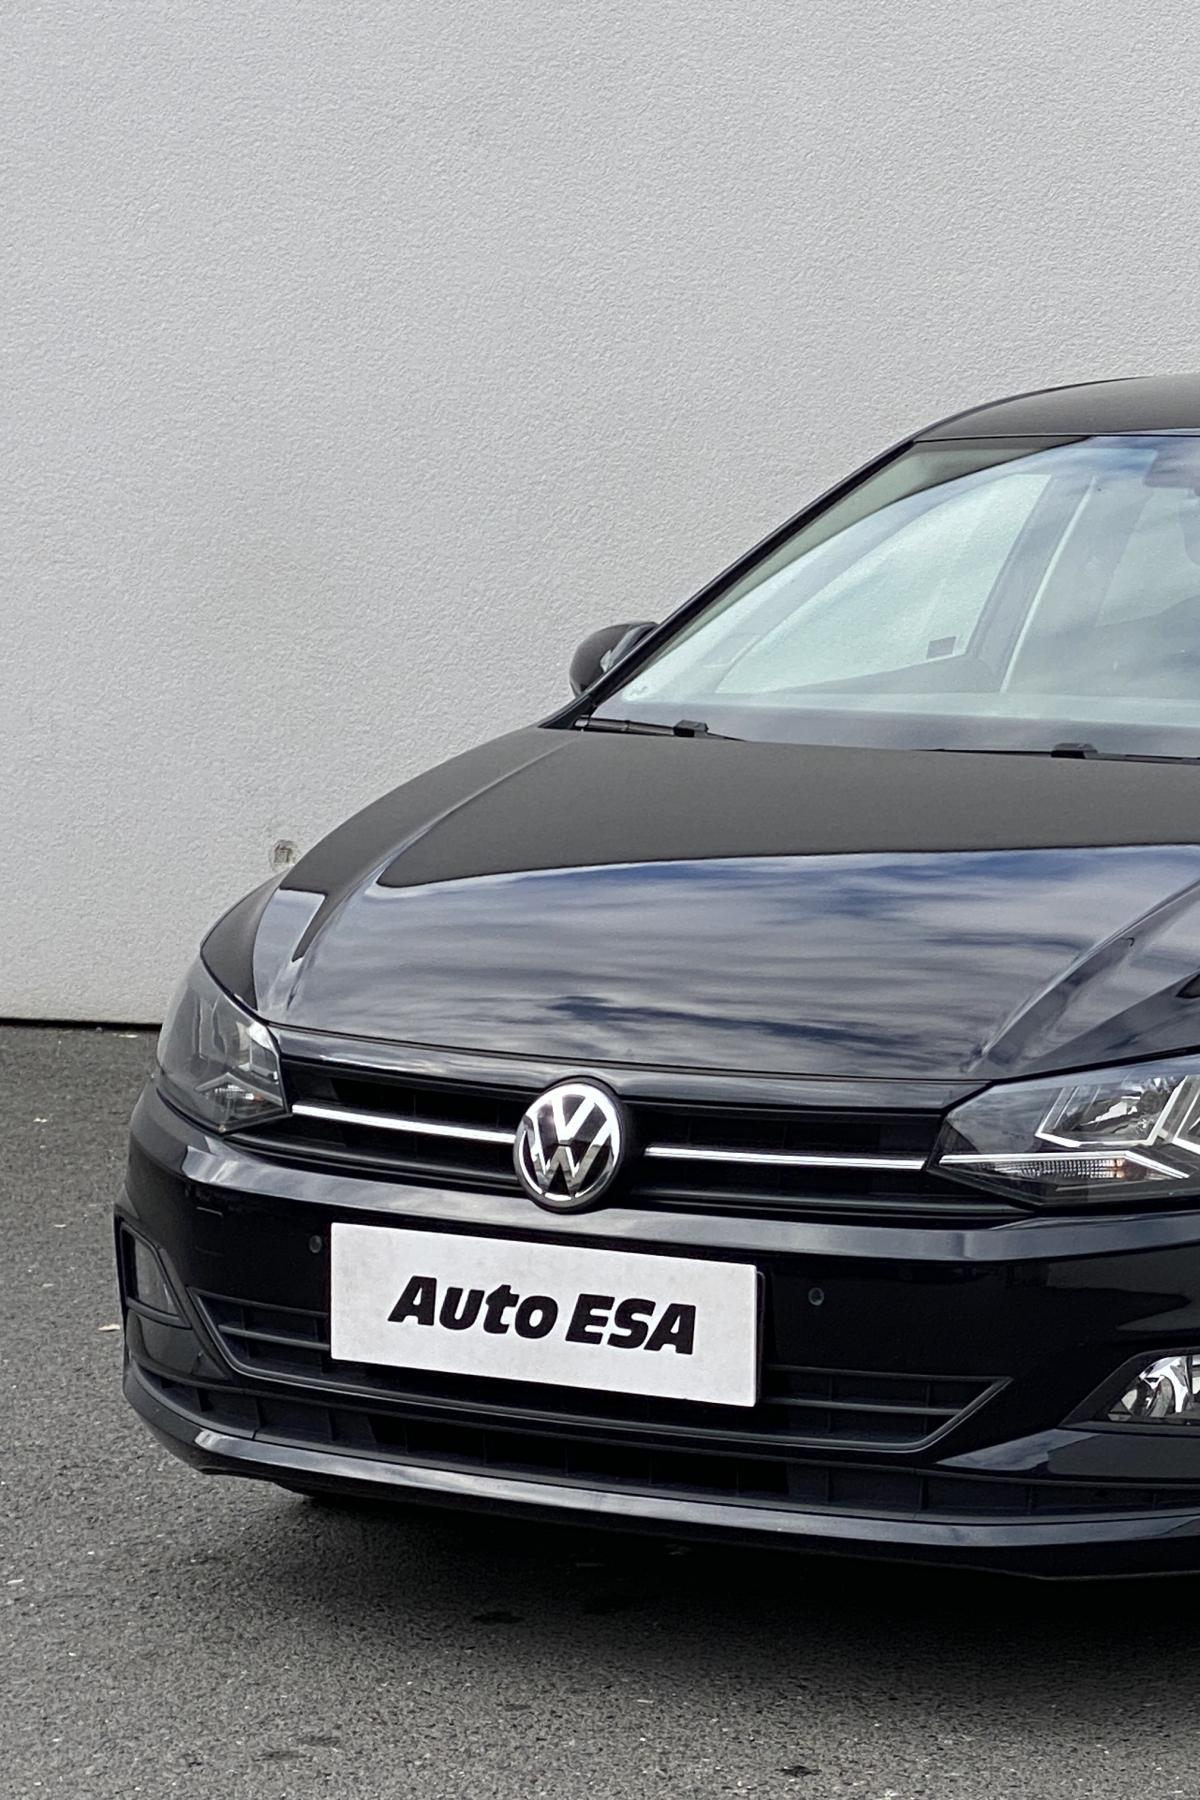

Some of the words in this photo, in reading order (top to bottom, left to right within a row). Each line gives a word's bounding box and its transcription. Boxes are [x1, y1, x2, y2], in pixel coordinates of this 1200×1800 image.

[517, 1087, 617, 1203] VW
[388, 1275, 559, 1339] Auto
[564, 1293, 697, 1355] ESA
